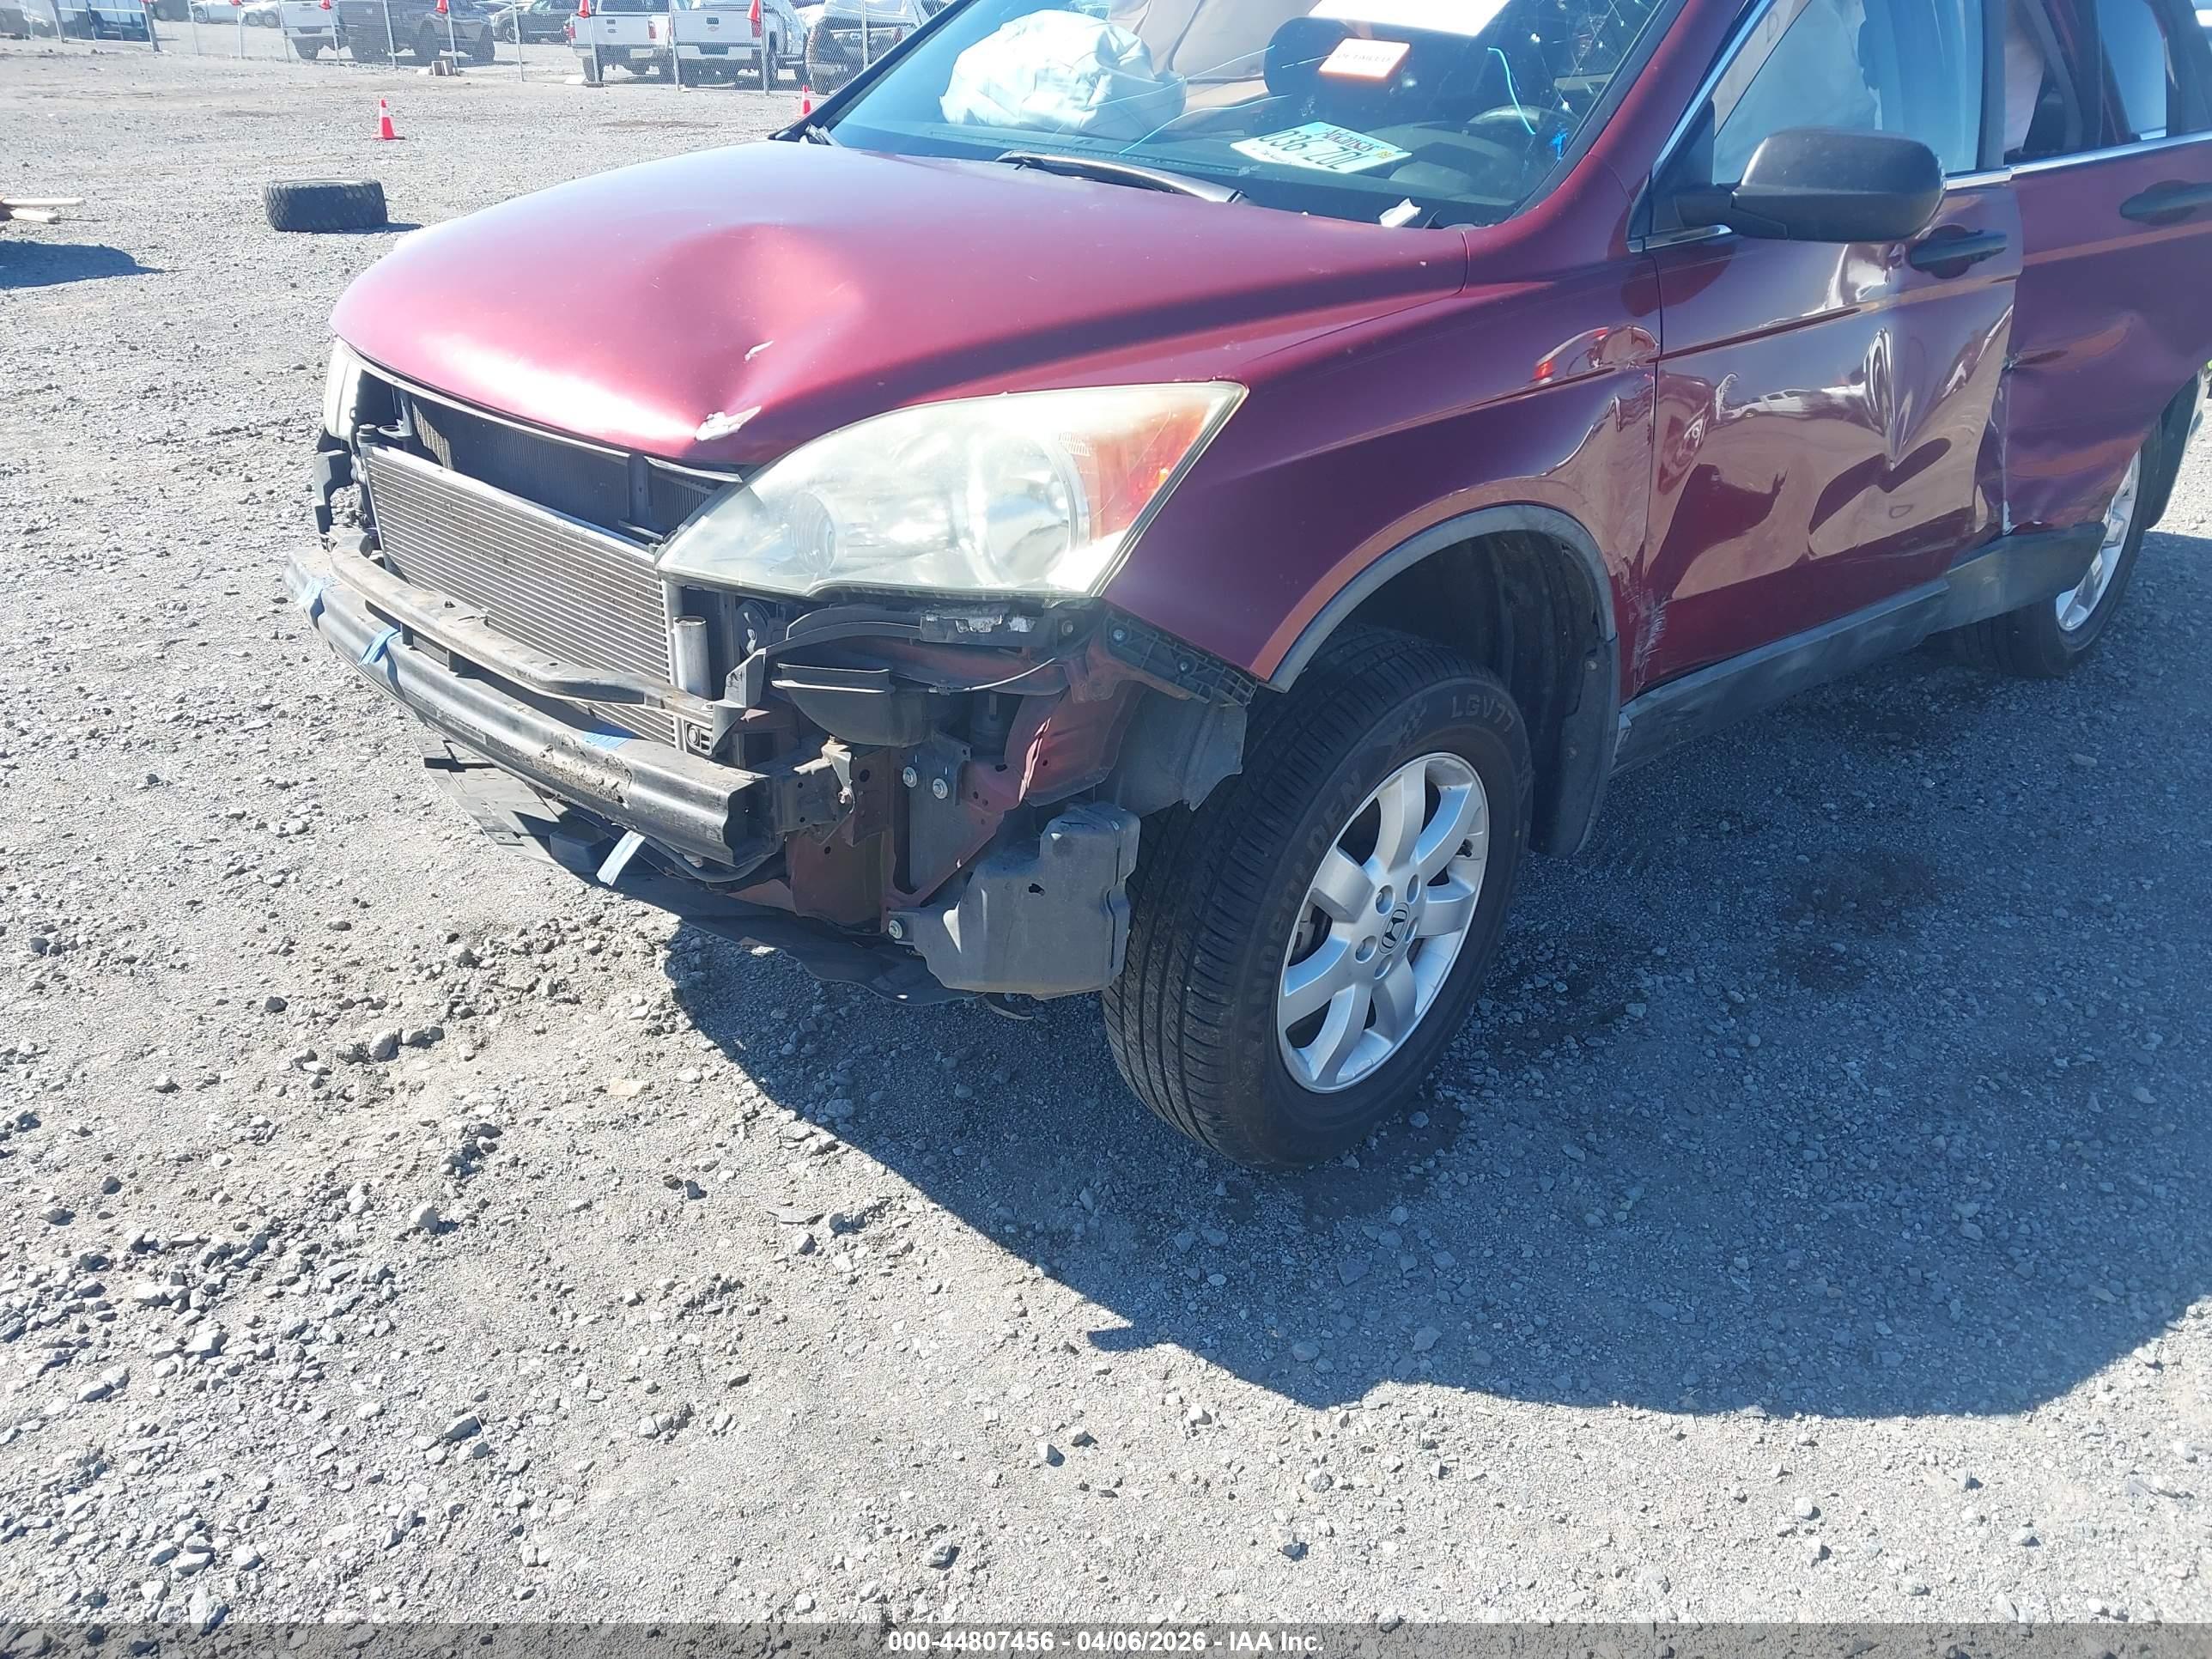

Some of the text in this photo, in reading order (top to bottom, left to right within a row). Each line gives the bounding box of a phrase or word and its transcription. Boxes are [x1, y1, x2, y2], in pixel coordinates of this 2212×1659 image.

[1258, 130, 1322, 151] 036
[1315, 128, 1380, 151] Arkansas
[1450, 694, 1516, 732] LGV77
